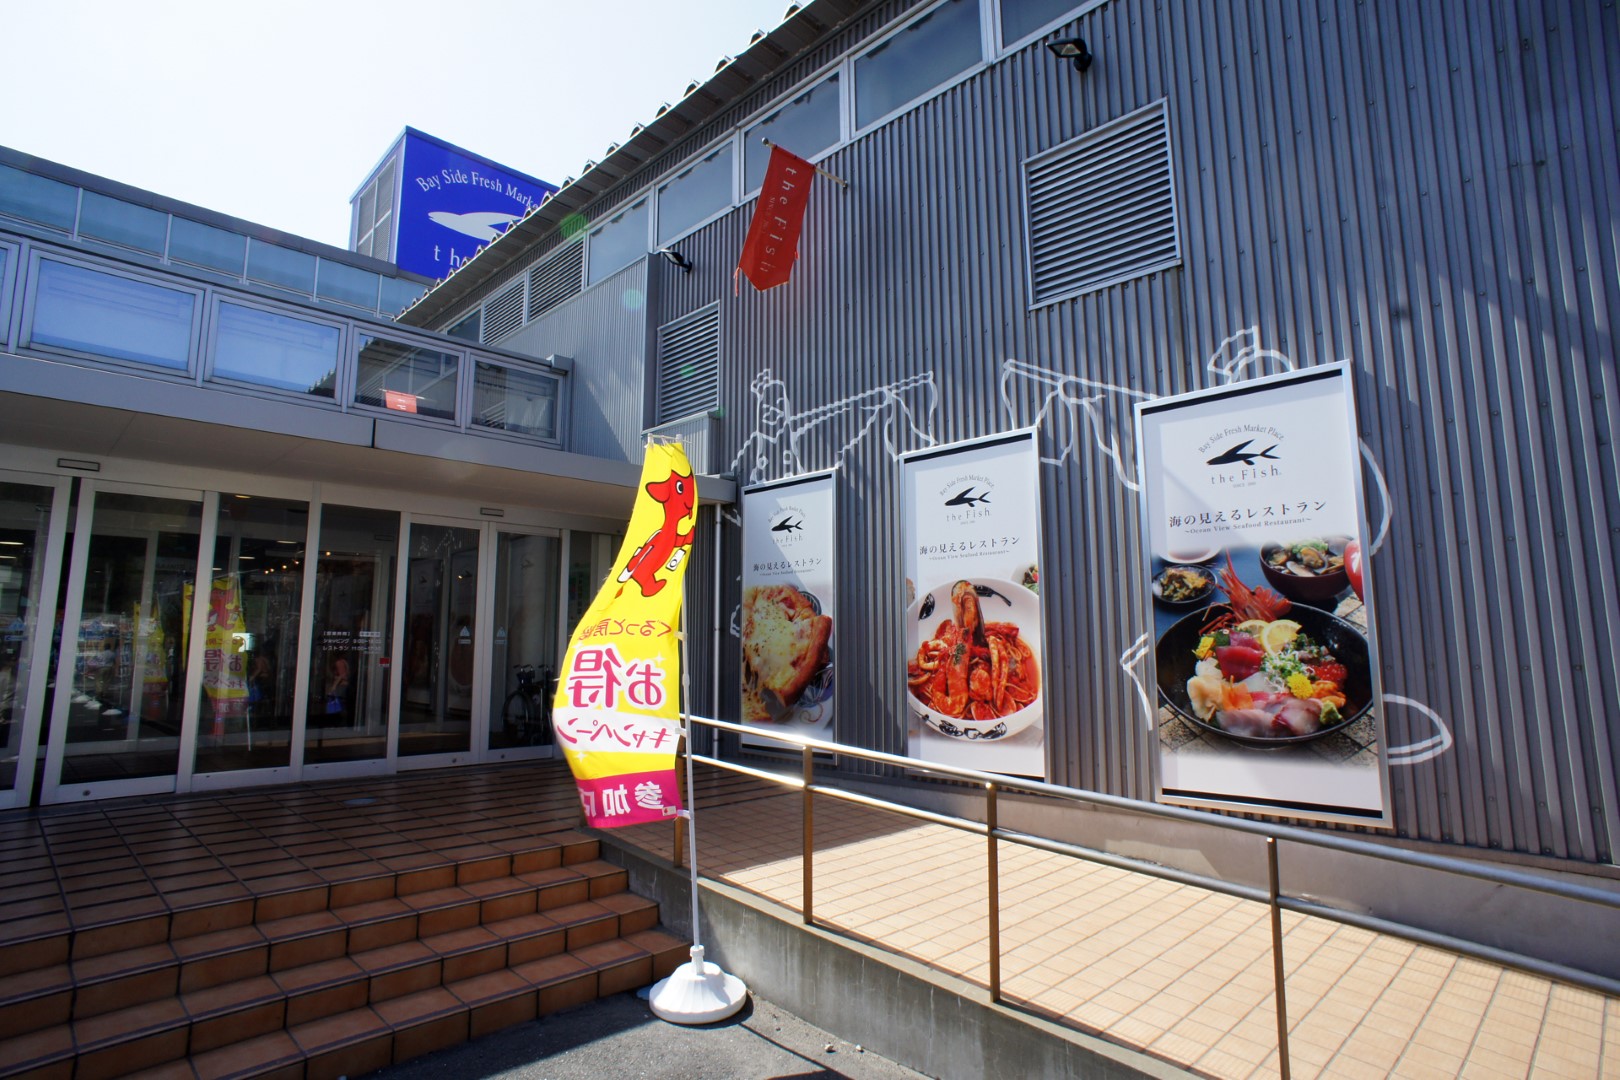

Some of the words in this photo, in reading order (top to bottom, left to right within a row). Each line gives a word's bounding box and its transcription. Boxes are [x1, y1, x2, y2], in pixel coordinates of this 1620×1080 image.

[416, 174, 441, 192] Bay
[442, 169, 469, 185] Side
[472, 171, 503, 193] Fresh
[505, 184, 539, 208] Marke
[779, 167, 797, 205] the
[434, 244, 460, 267] th
[1198, 443, 1211, 453] Bay
[1209, 432, 1223, 444] Side
[1224, 425, 1242, 437] Fresh
[1243, 424, 1267, 433] Market
[1267, 426, 1285, 441] Place
[1211, 474, 1234, 485] the
[1241, 464, 1279, 481] Fish
[946, 513, 962, 522] the
[966, 507, 990, 519] Fish
[1169, 501, 1327, 528] 海の見えるレストラン
[1213, 525, 1231, 533] View
[1232, 522, 1262, 531] Seafood
[919, 536, 1020, 556] 海の見えるレストラン
